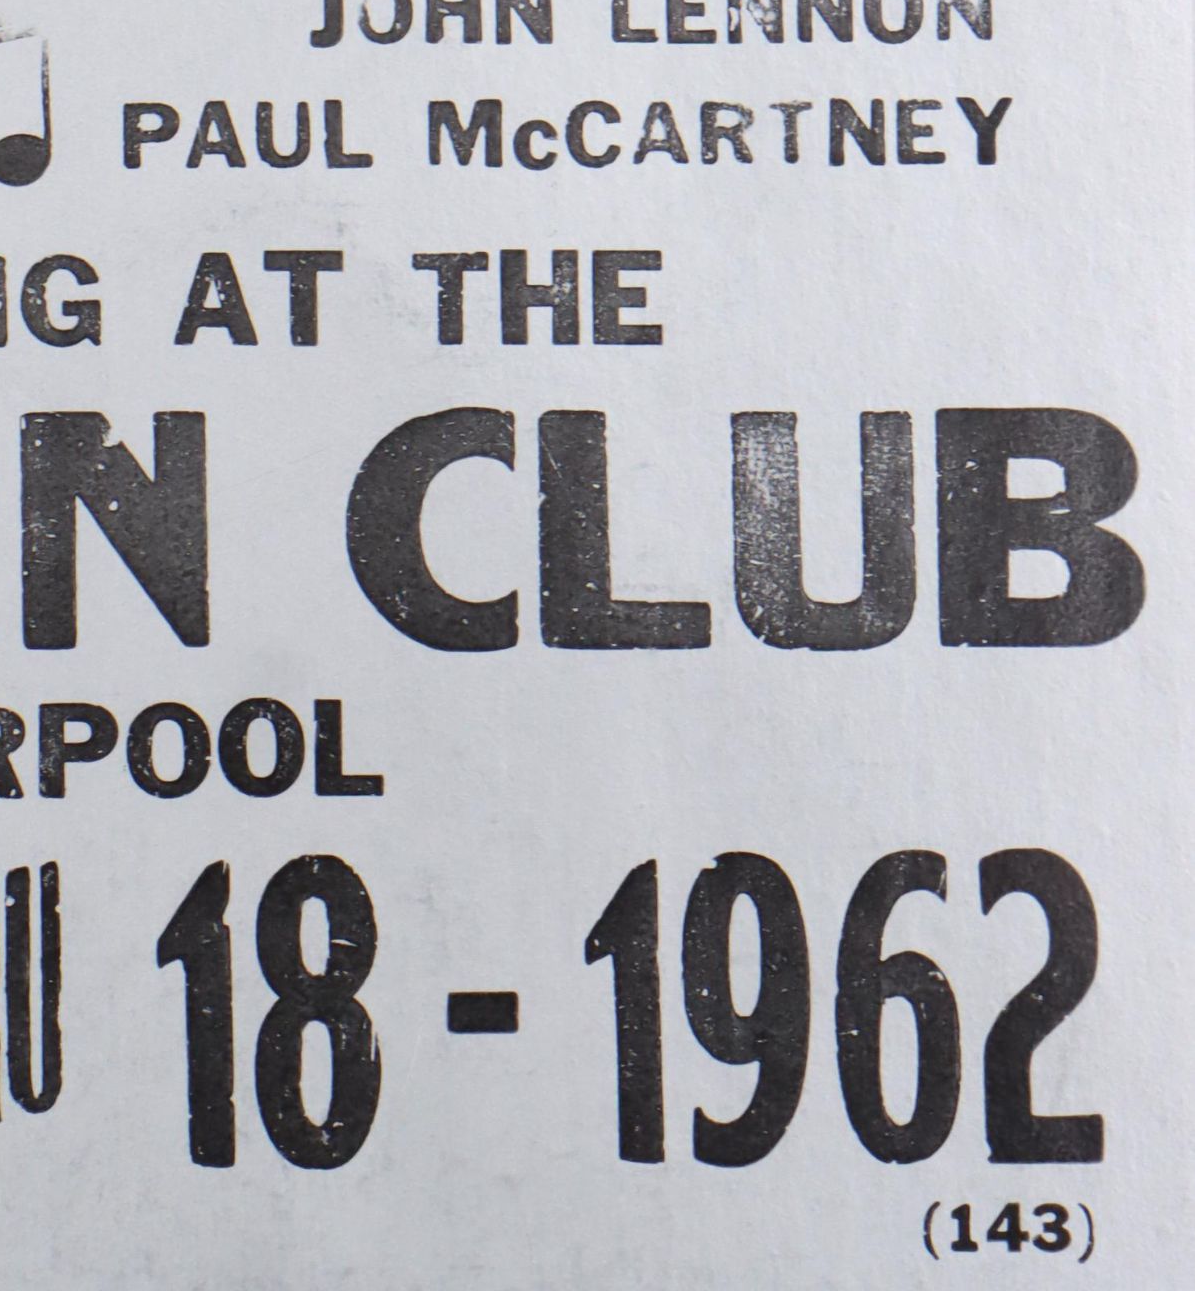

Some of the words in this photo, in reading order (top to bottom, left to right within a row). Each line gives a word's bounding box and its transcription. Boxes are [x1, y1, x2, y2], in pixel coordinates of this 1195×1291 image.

[123, 100, 373, 169] PAUL
[428, 97, 1011, 170] McCARTNEY
[174, 250, 343, 346] AT
[412, 249, 662, 345] THE
[346, 407, 1145, 652] CLUB
[156, 854, 382, 1170] 18
[584, 848, 1104, 1168] 1962
[923, 1202, 1094, 1263] (143)
